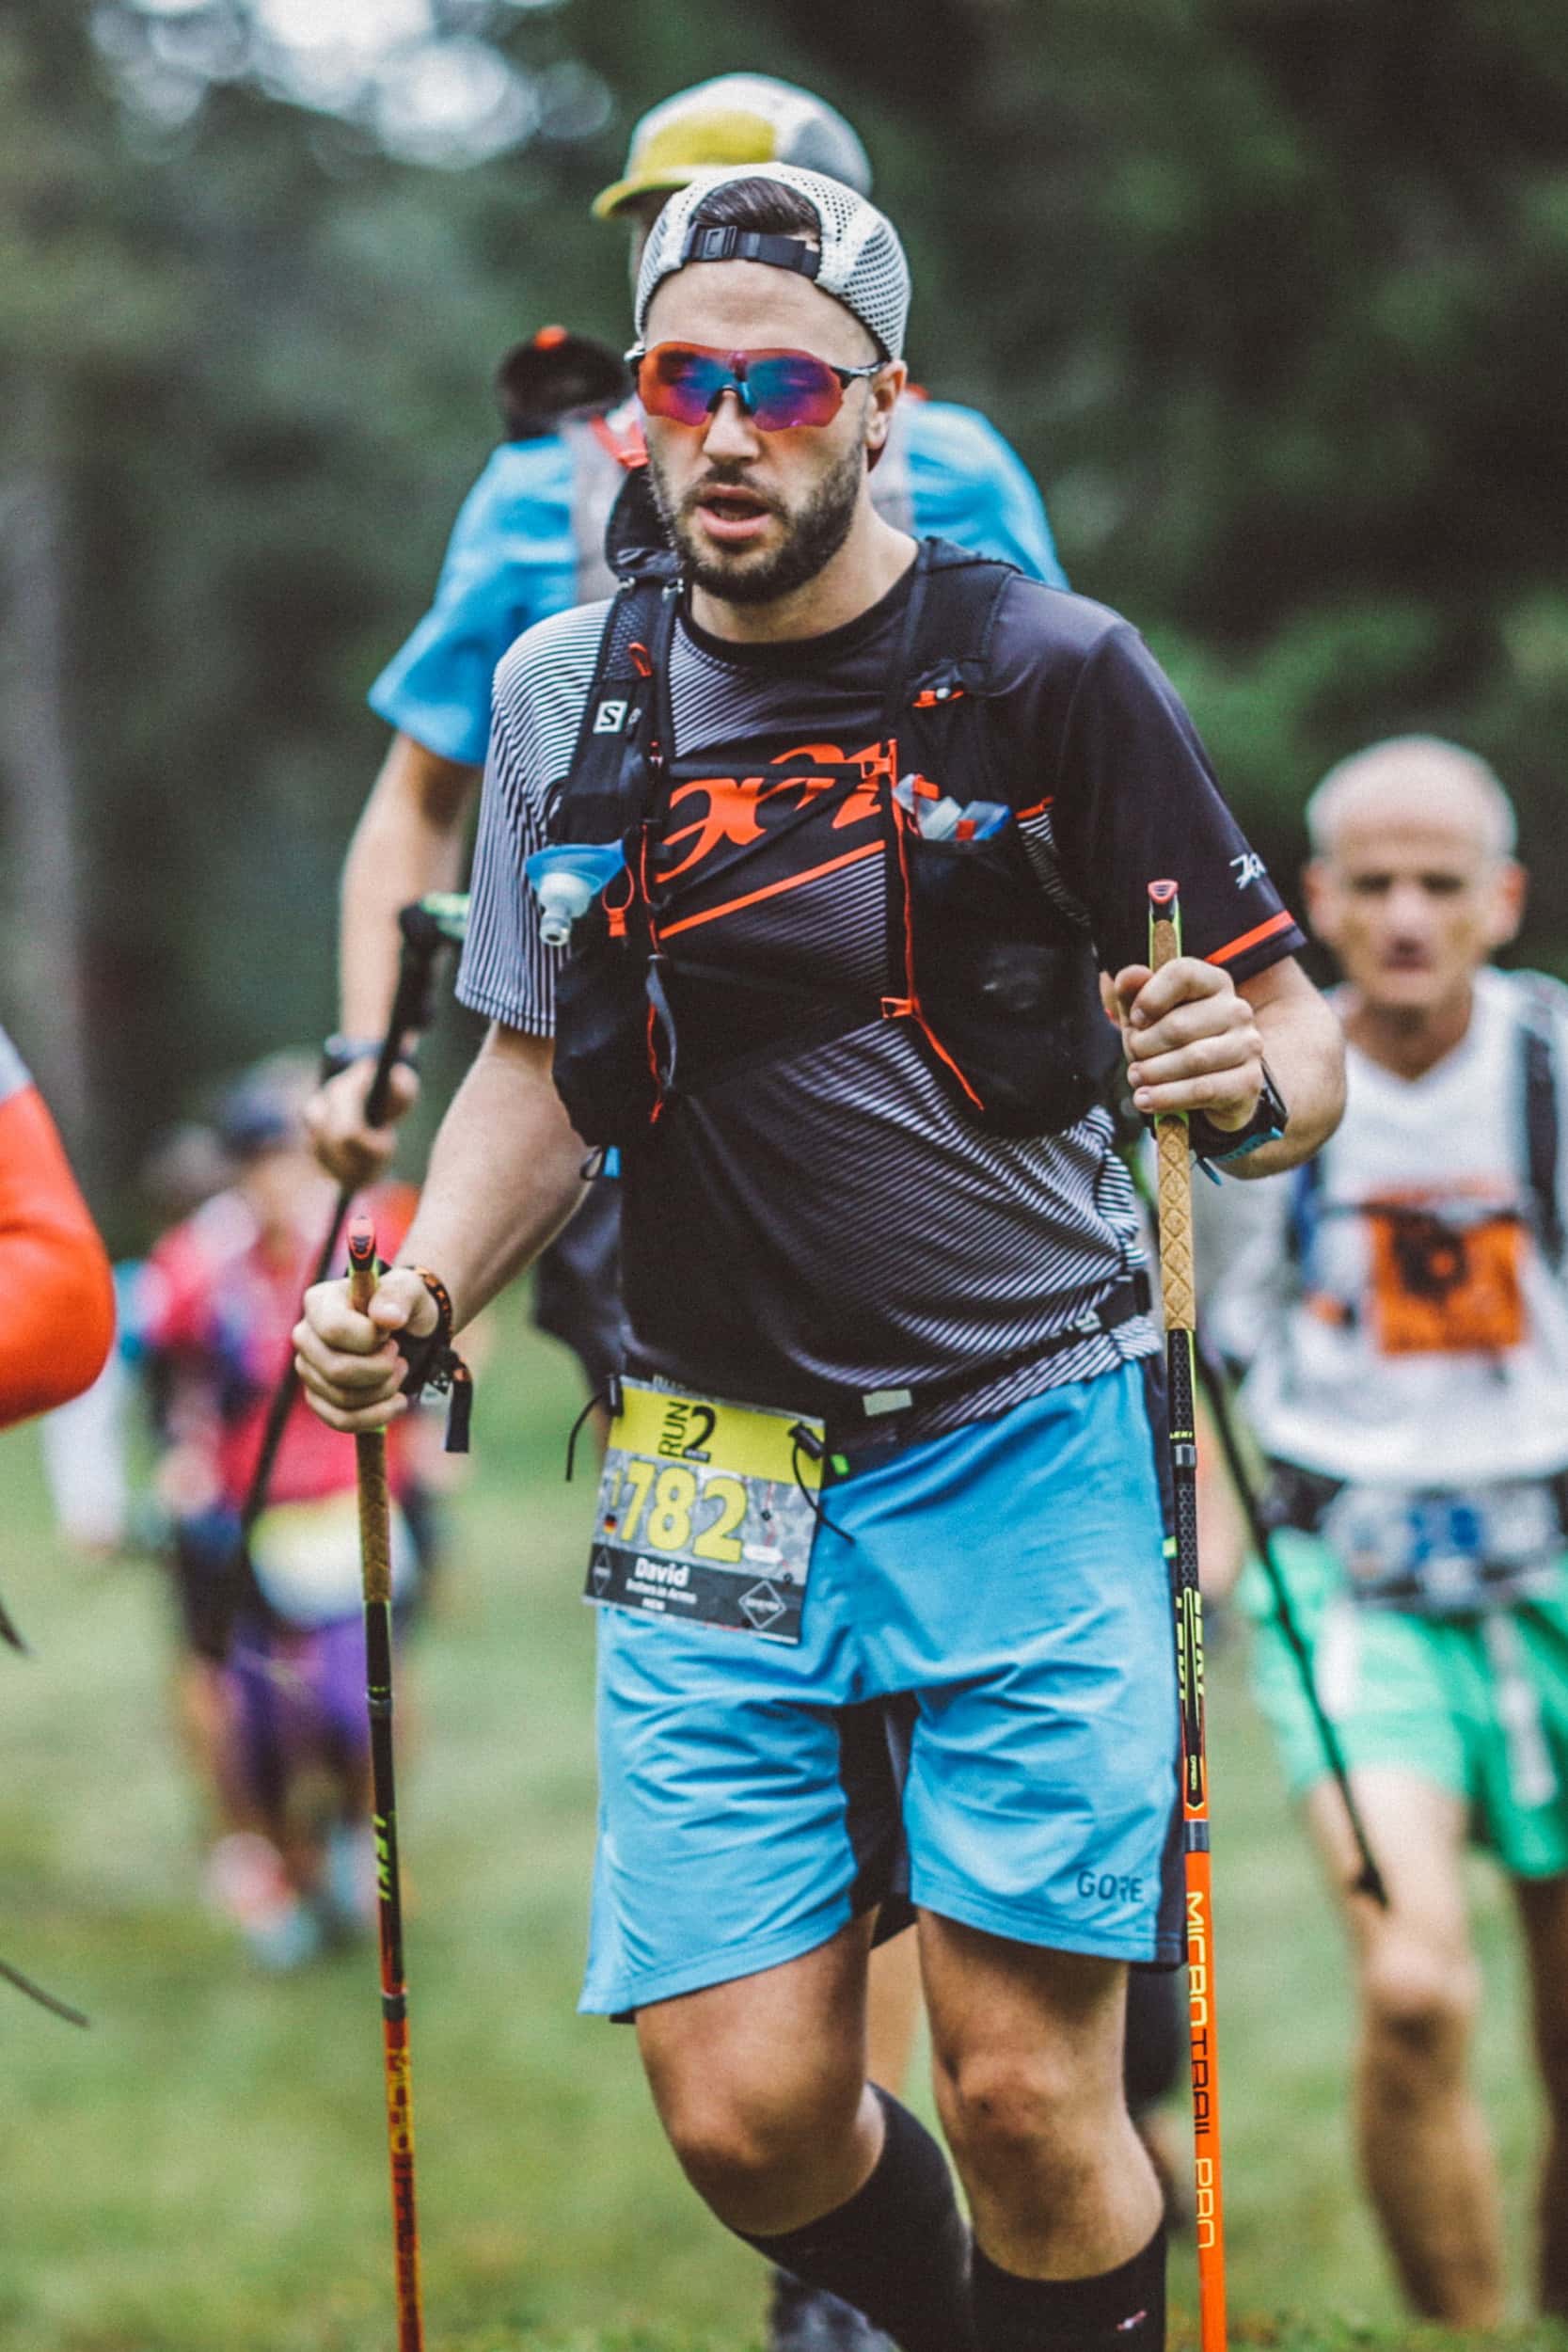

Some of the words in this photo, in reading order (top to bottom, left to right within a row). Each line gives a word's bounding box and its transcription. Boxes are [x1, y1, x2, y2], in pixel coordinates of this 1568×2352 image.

[658, 1400, 690, 1457] RUN
[681, 1405, 716, 1463] 2
[633, 1556, 690, 1588] David
